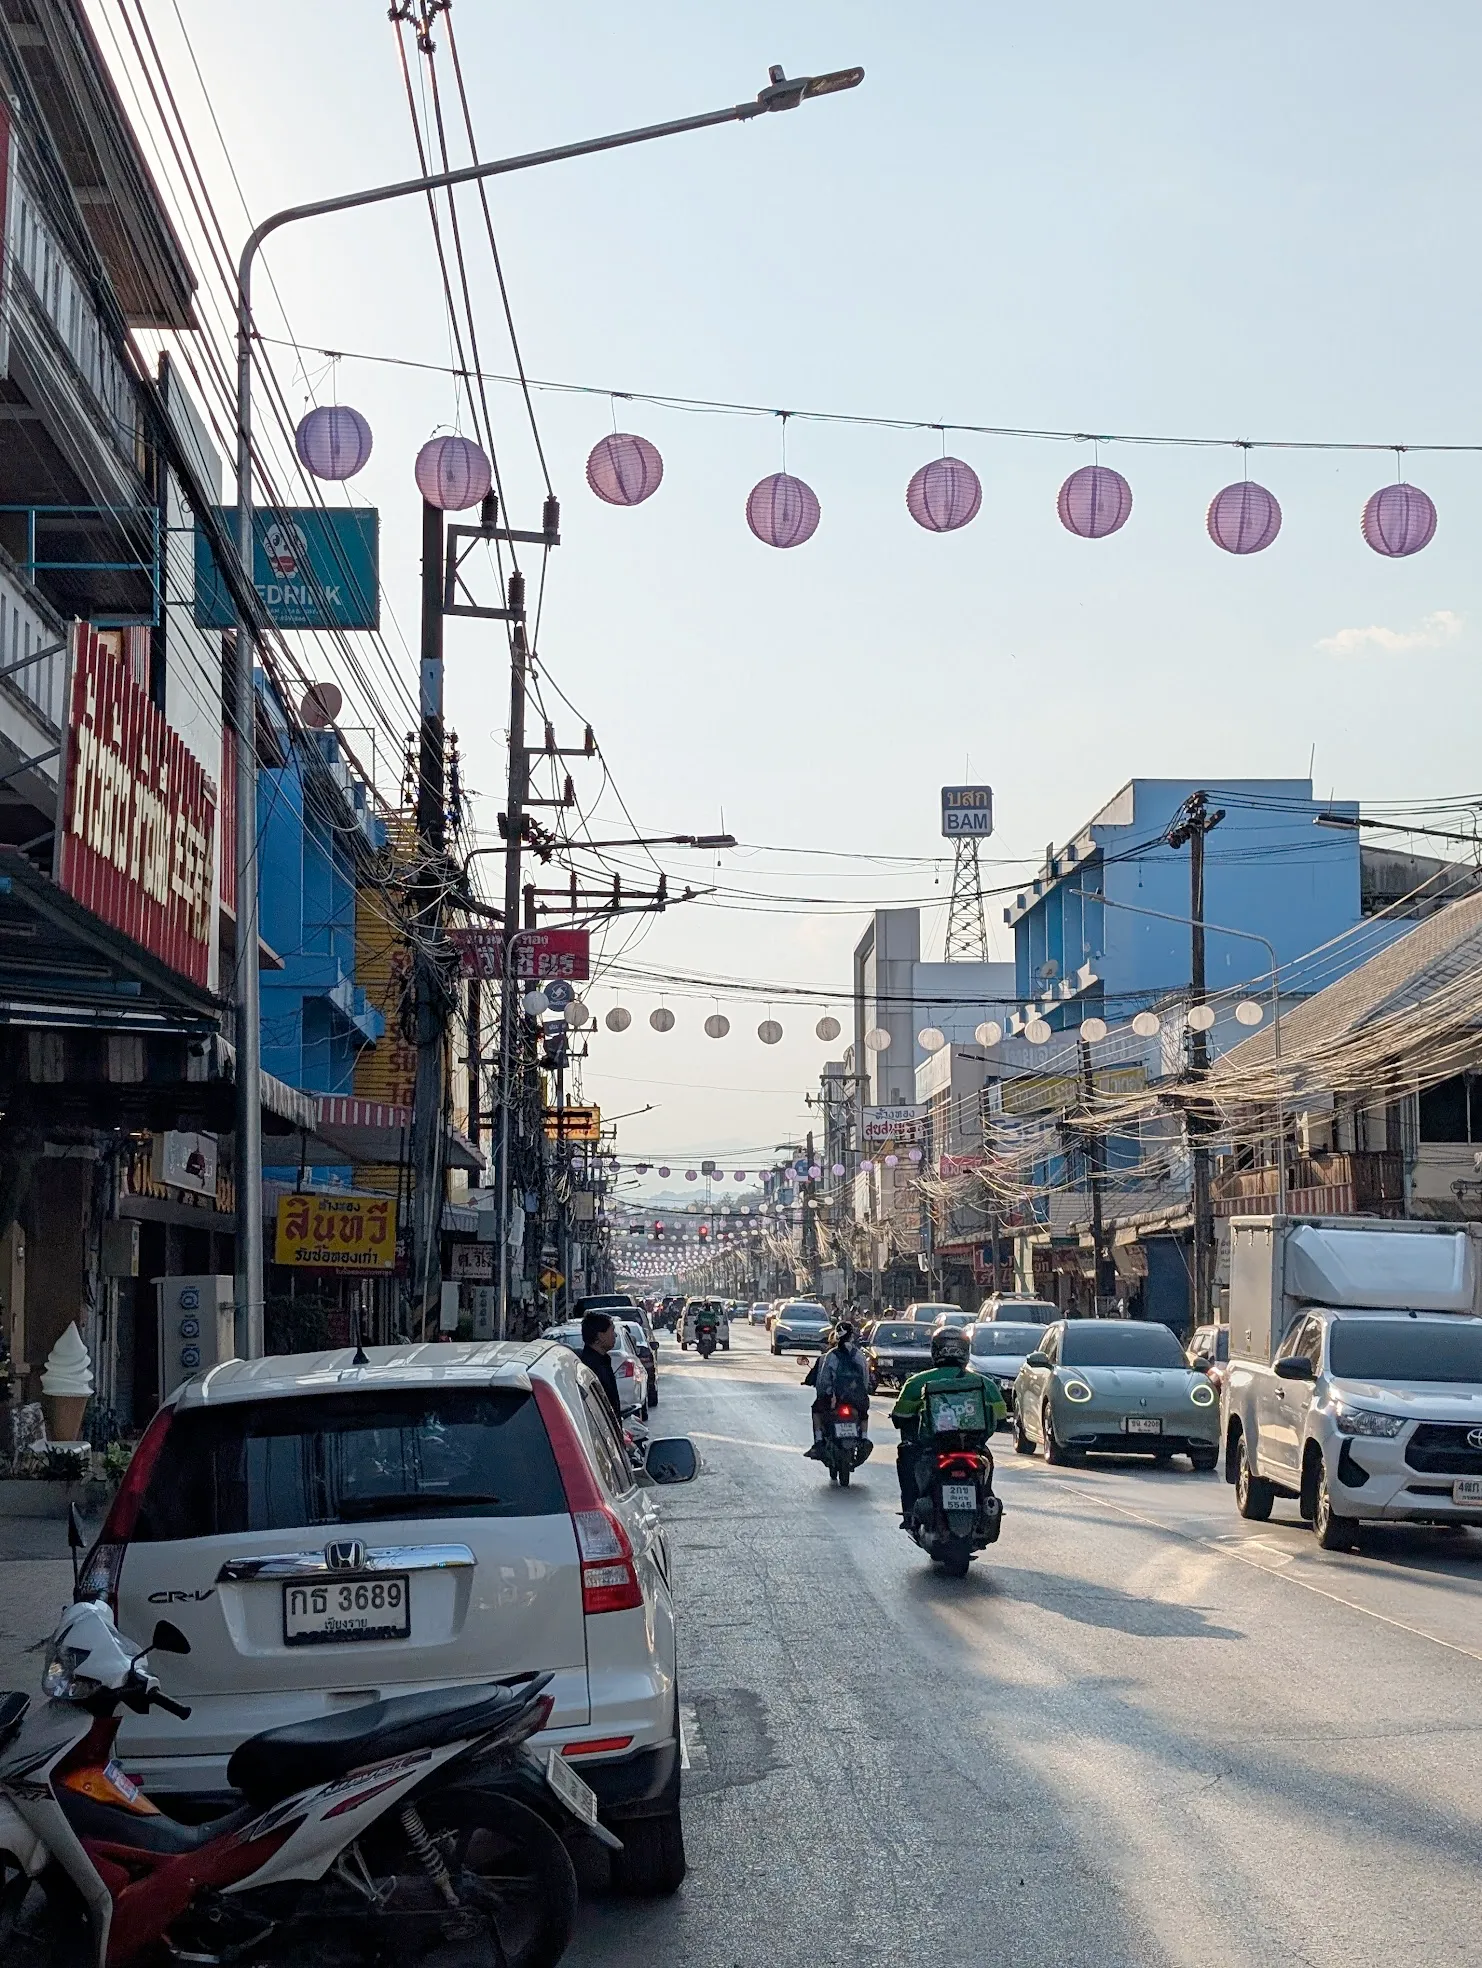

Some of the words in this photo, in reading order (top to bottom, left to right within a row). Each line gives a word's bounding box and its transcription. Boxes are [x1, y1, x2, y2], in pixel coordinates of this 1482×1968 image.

[947, 791, 988, 807] บสก
[947, 813, 988, 830] BAM
[285, 1198, 389, 1245] สินทวี
[295, 1245, 379, 1264] รับซื้อทองเก่า
[290, 1588, 329, 1616] กธ
[338, 1582, 401, 1612] 3689
[324, 1616, 368, 1632] เชียงราย
